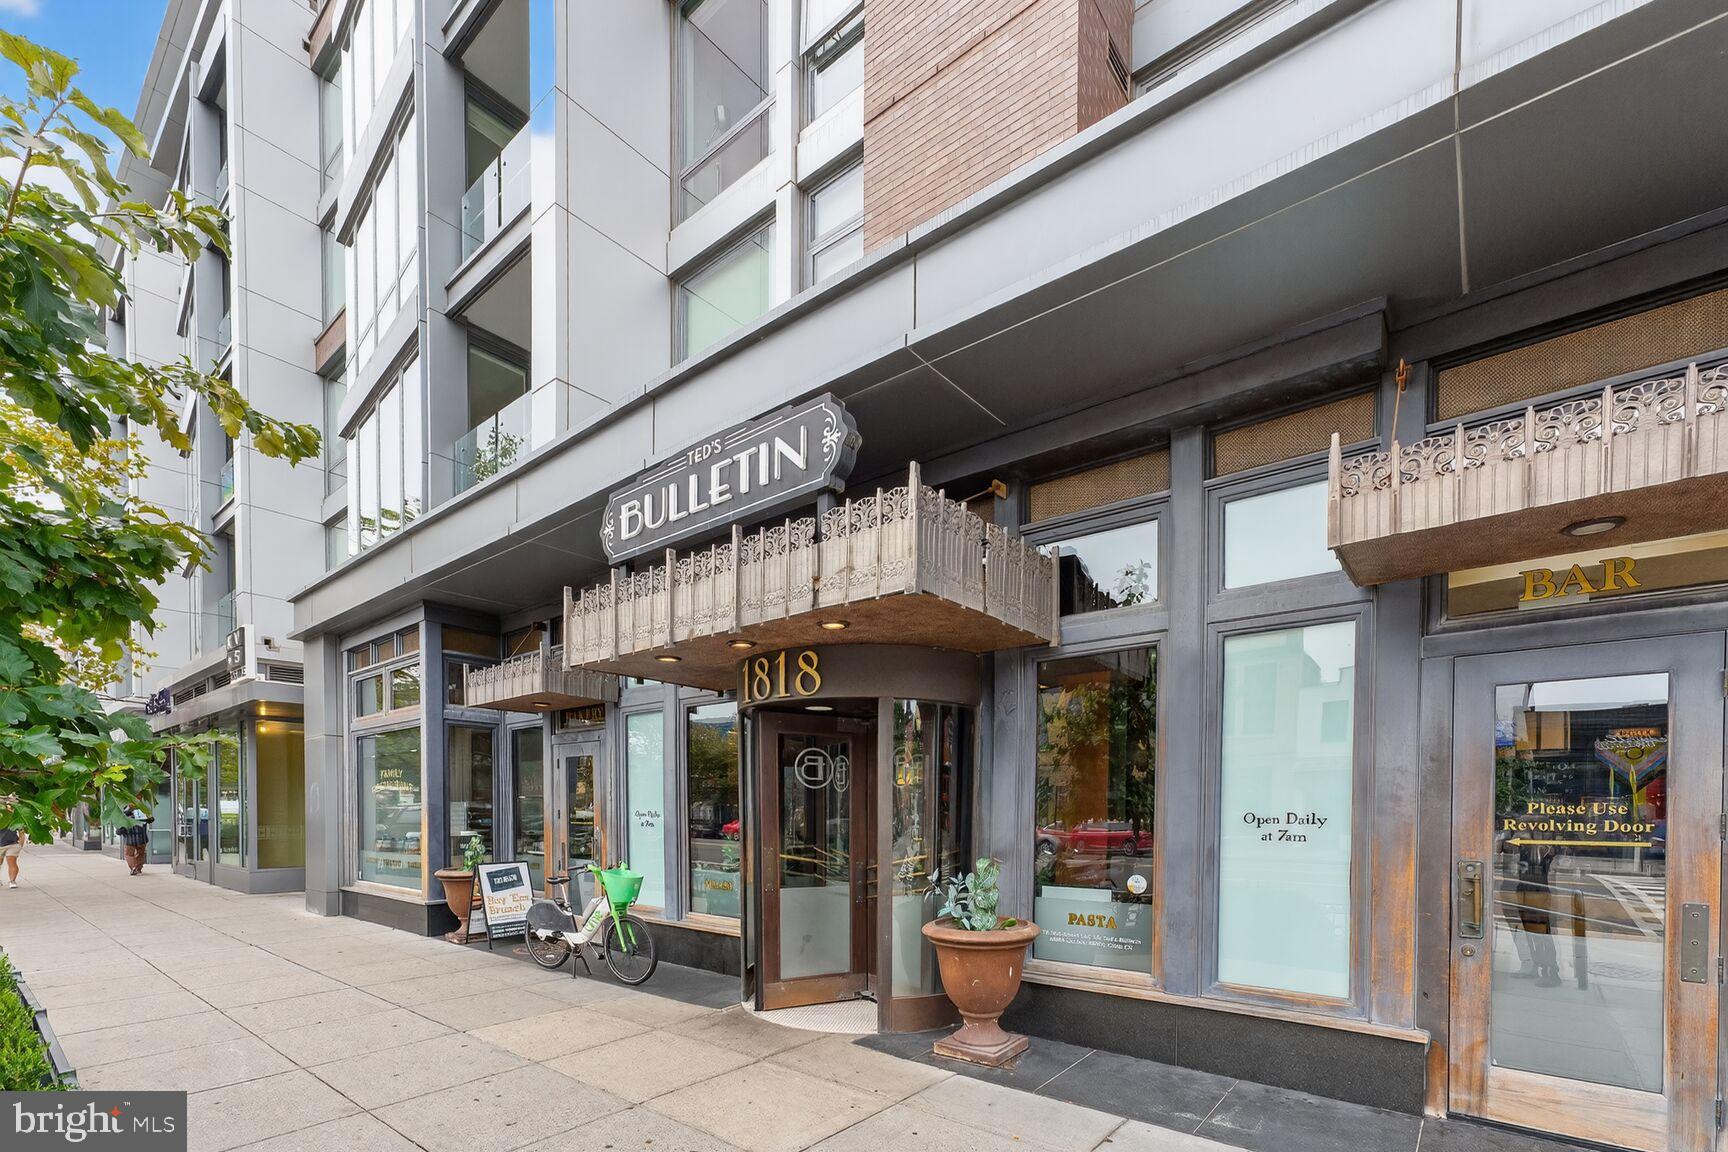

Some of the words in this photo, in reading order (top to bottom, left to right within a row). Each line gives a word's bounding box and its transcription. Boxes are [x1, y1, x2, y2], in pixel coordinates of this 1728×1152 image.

[686, 438, 723, 466] TED'S
[619, 425, 808, 541] BULLETIN
[1518, 556, 1643, 602] BAR
[742, 650, 822, 703] 1818
[1526, 802, 1586, 815] Please
[1593, 802, 1629, 815] Use
[1243, 812, 1281, 829] Open
[1286, 811, 1328, 828] Daily
[1503, 818, 1598, 835] Revolving
[1604, 819, 1656, 833] Door
[1260, 831, 1273, 842] at
[1277, 829, 1307, 843] 7am
[1067, 912, 1118, 929] PASTA
